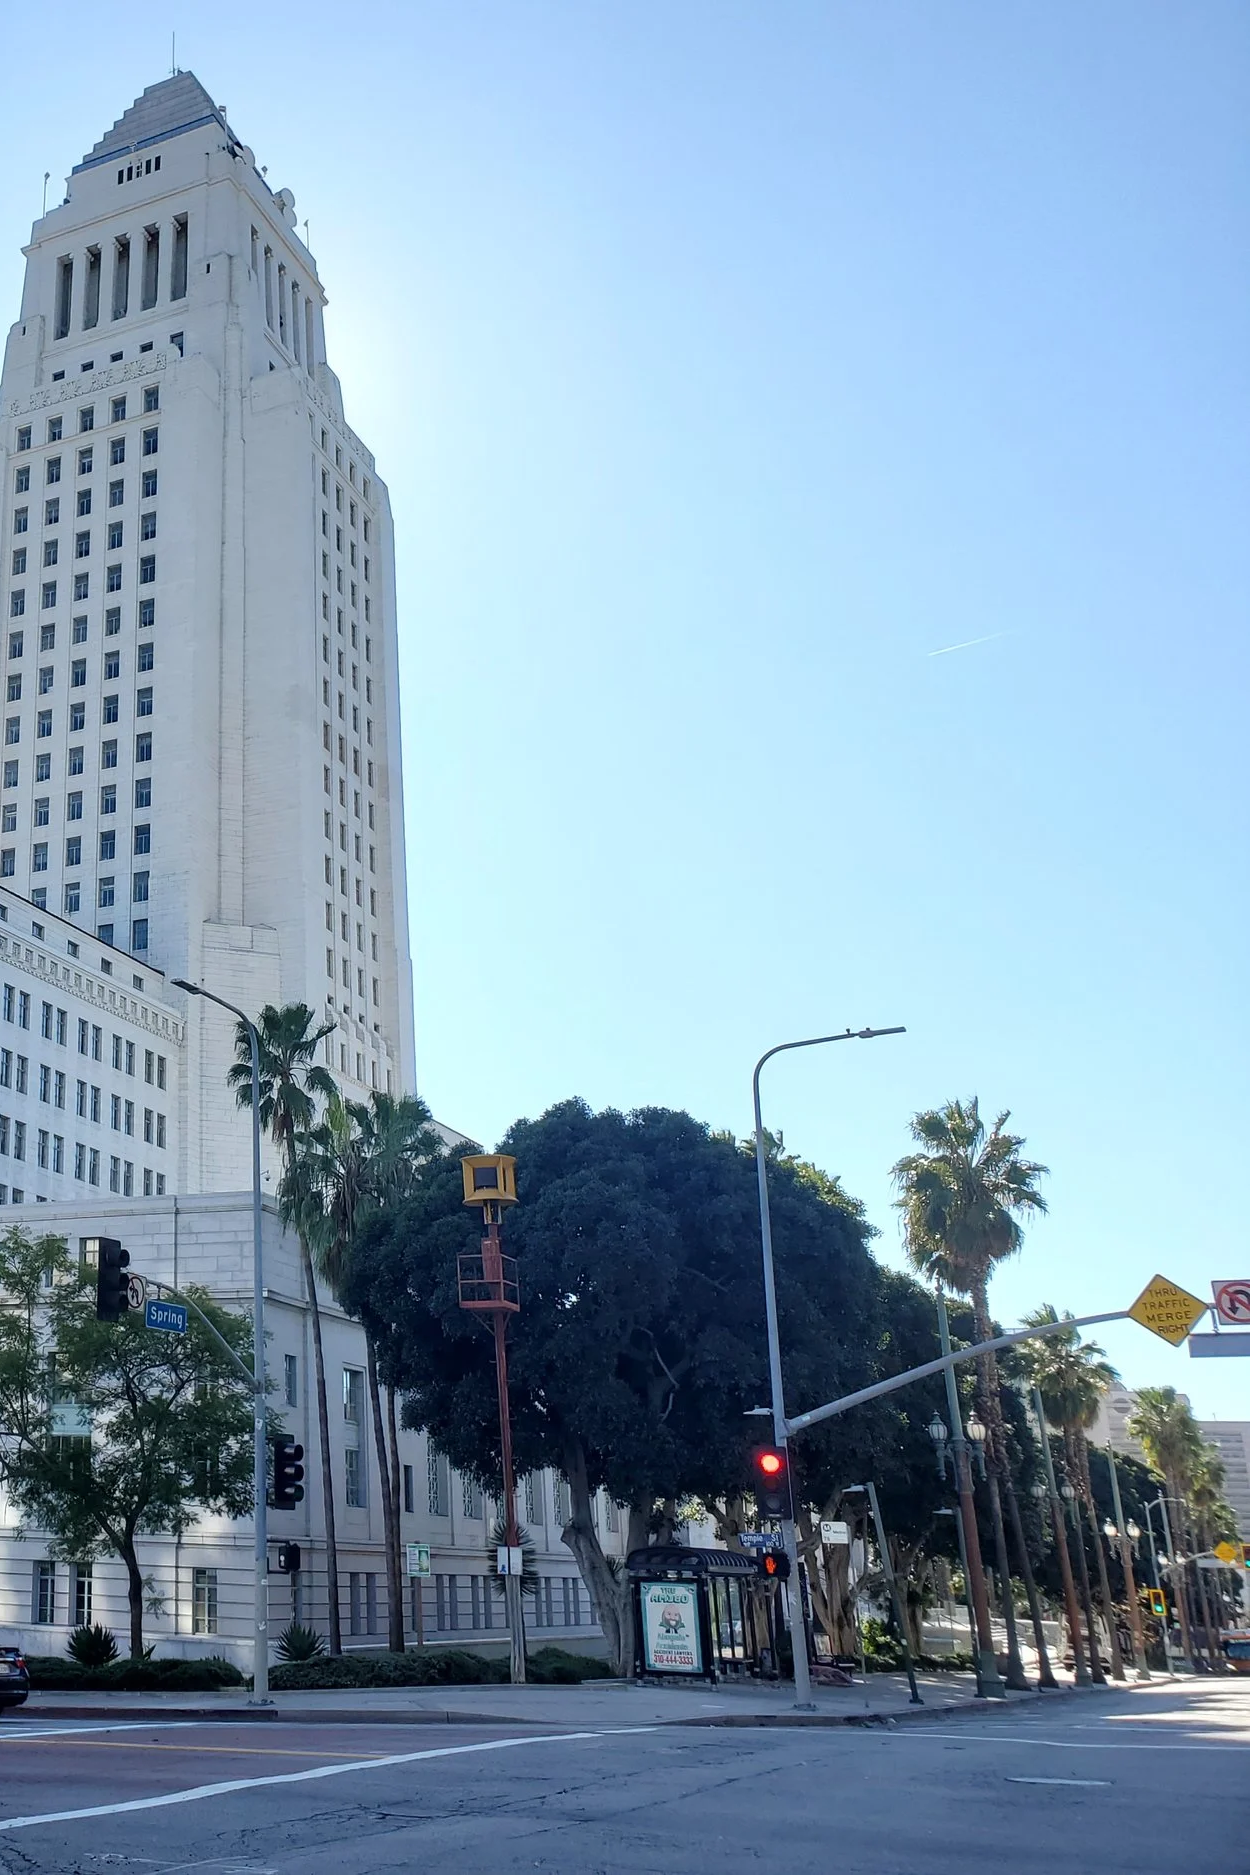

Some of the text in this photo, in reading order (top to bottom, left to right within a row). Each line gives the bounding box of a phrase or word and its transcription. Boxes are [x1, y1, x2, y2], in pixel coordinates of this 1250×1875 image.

[1148, 1288, 1178, 1298] THRU
[1141, 1298, 1190, 1311] TRAFFIC
[150, 1306, 183, 1329] Spring
[1146, 1310, 1193, 1323] MERGE
[1157, 1323, 1190, 1334] RIGHT
[740, 1534, 779, 1543] Temple St
[650, 1594, 689, 1604] AMIGO
[653, 1654, 694, 1665] 310-444-3333
